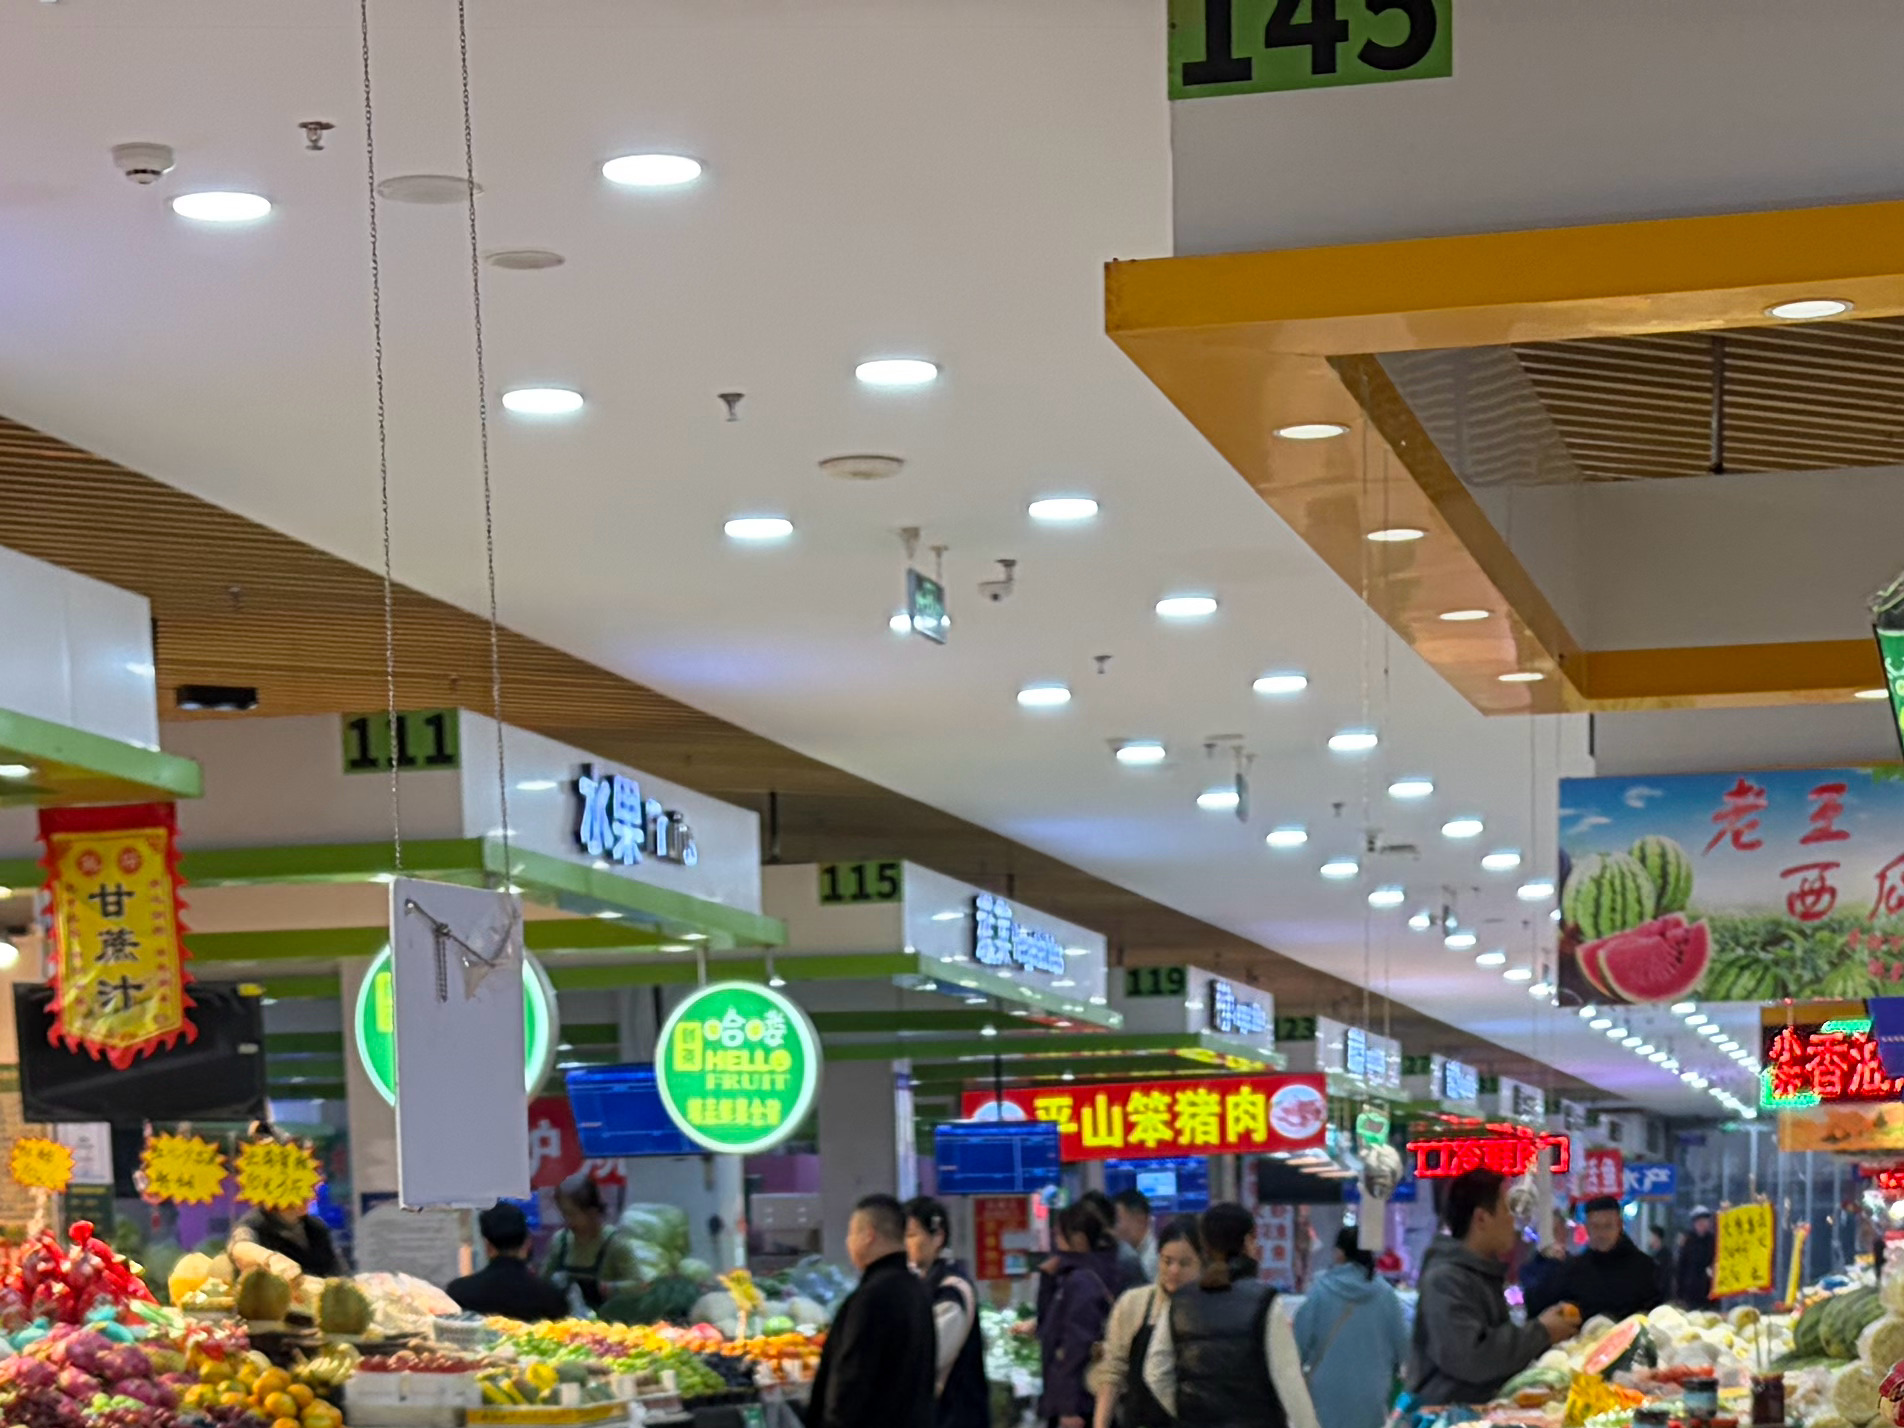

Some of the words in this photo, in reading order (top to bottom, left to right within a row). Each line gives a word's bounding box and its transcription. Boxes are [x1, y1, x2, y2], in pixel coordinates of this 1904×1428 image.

[348, 711, 457, 769] 111
[579, 774, 643, 866] 水果
[823, 862, 900, 902] 115
[87, 882, 145, 1012] 甘蔗汁
[1127, 967, 1186, 997] 119
[705, 1050, 793, 1073] HELLO
[705, 1073, 790, 1091] FRUIT
[1032, 1085, 1269, 1149] 平山笨猪肉
